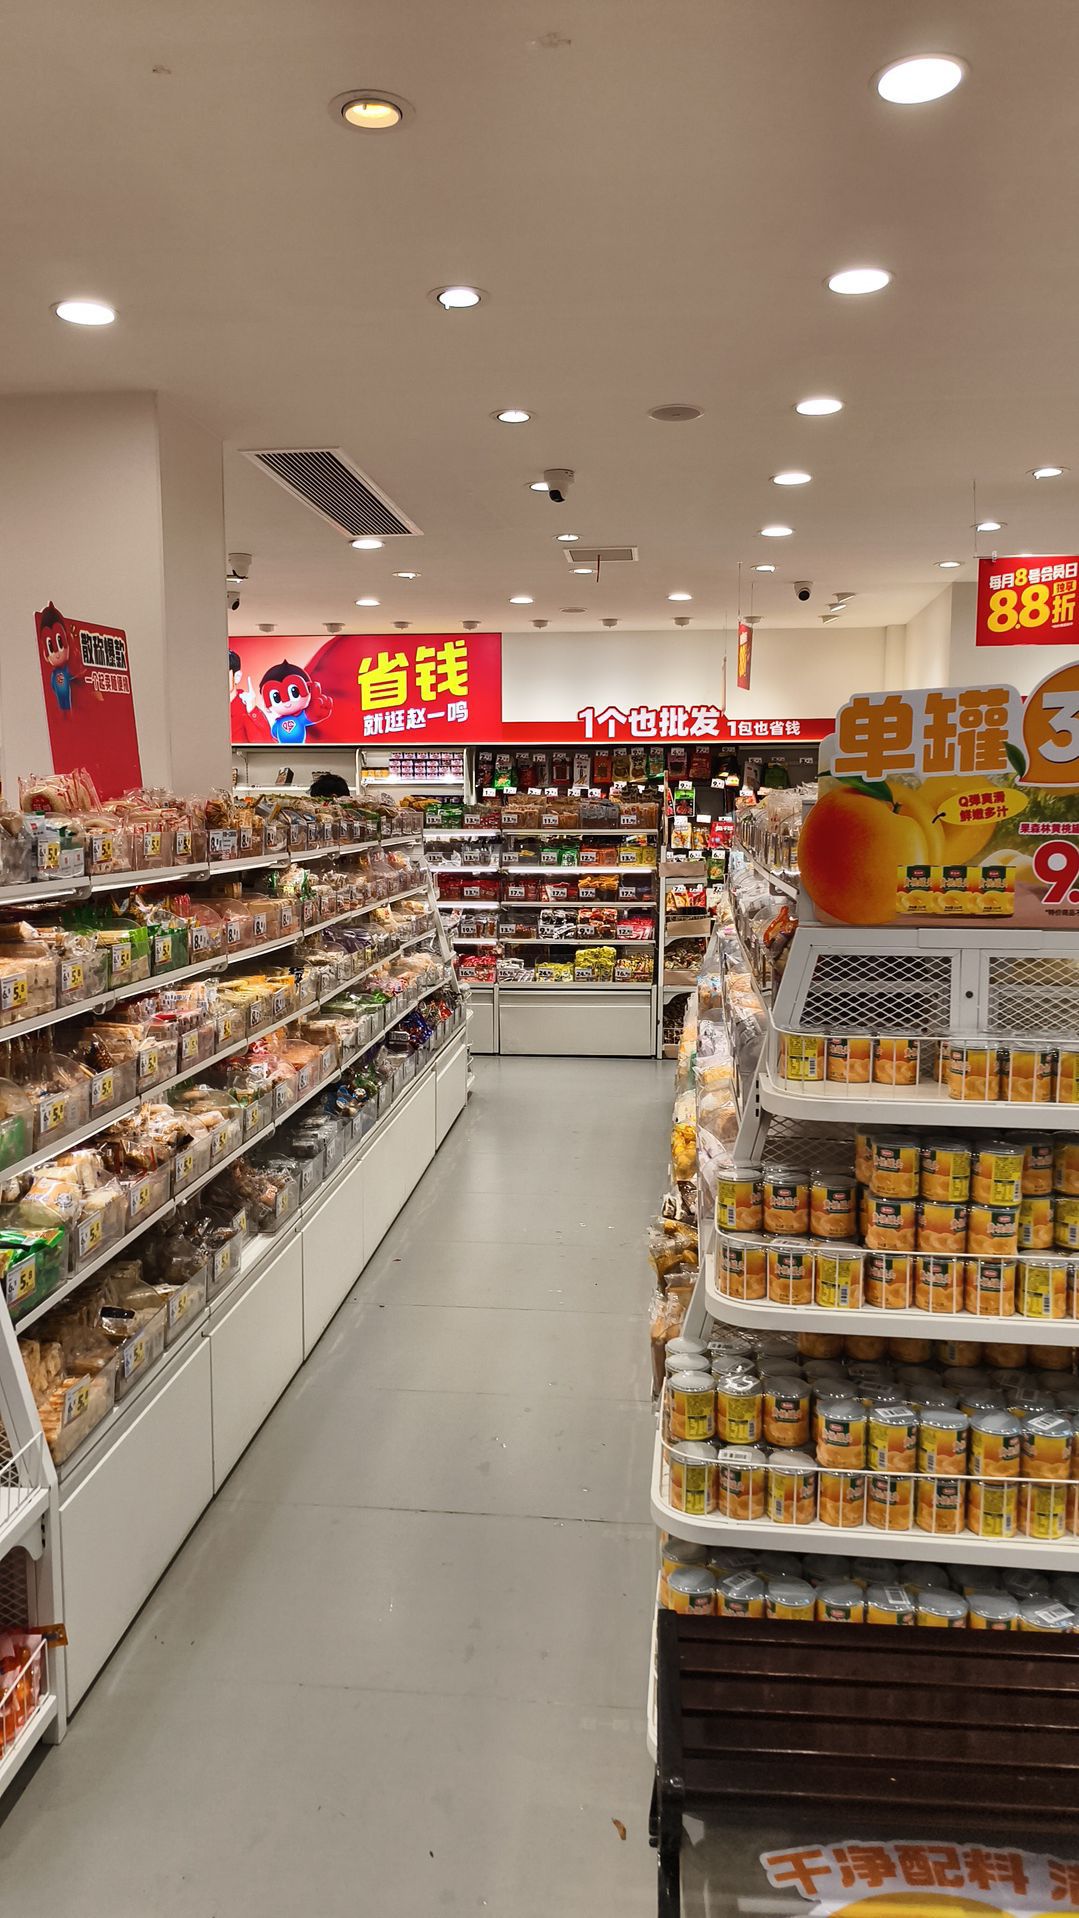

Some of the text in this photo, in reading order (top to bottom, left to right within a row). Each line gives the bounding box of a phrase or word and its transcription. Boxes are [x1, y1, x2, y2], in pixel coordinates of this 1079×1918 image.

[990, 562, 1078, 590] 每月8号会员日
[987, 584, 1050, 633] 8.8
[1051, 594, 1076, 624] 折
[357, 639, 469, 711] 省钱
[363, 701, 469, 737] 就逛赵一鸣
[579, 706, 720, 738] 1个也批发
[727, 720, 801, 737] 1包也省钱
[835, 689, 1010, 779] 单罐
[767, 1844, 1029, 1896] 干净配料
